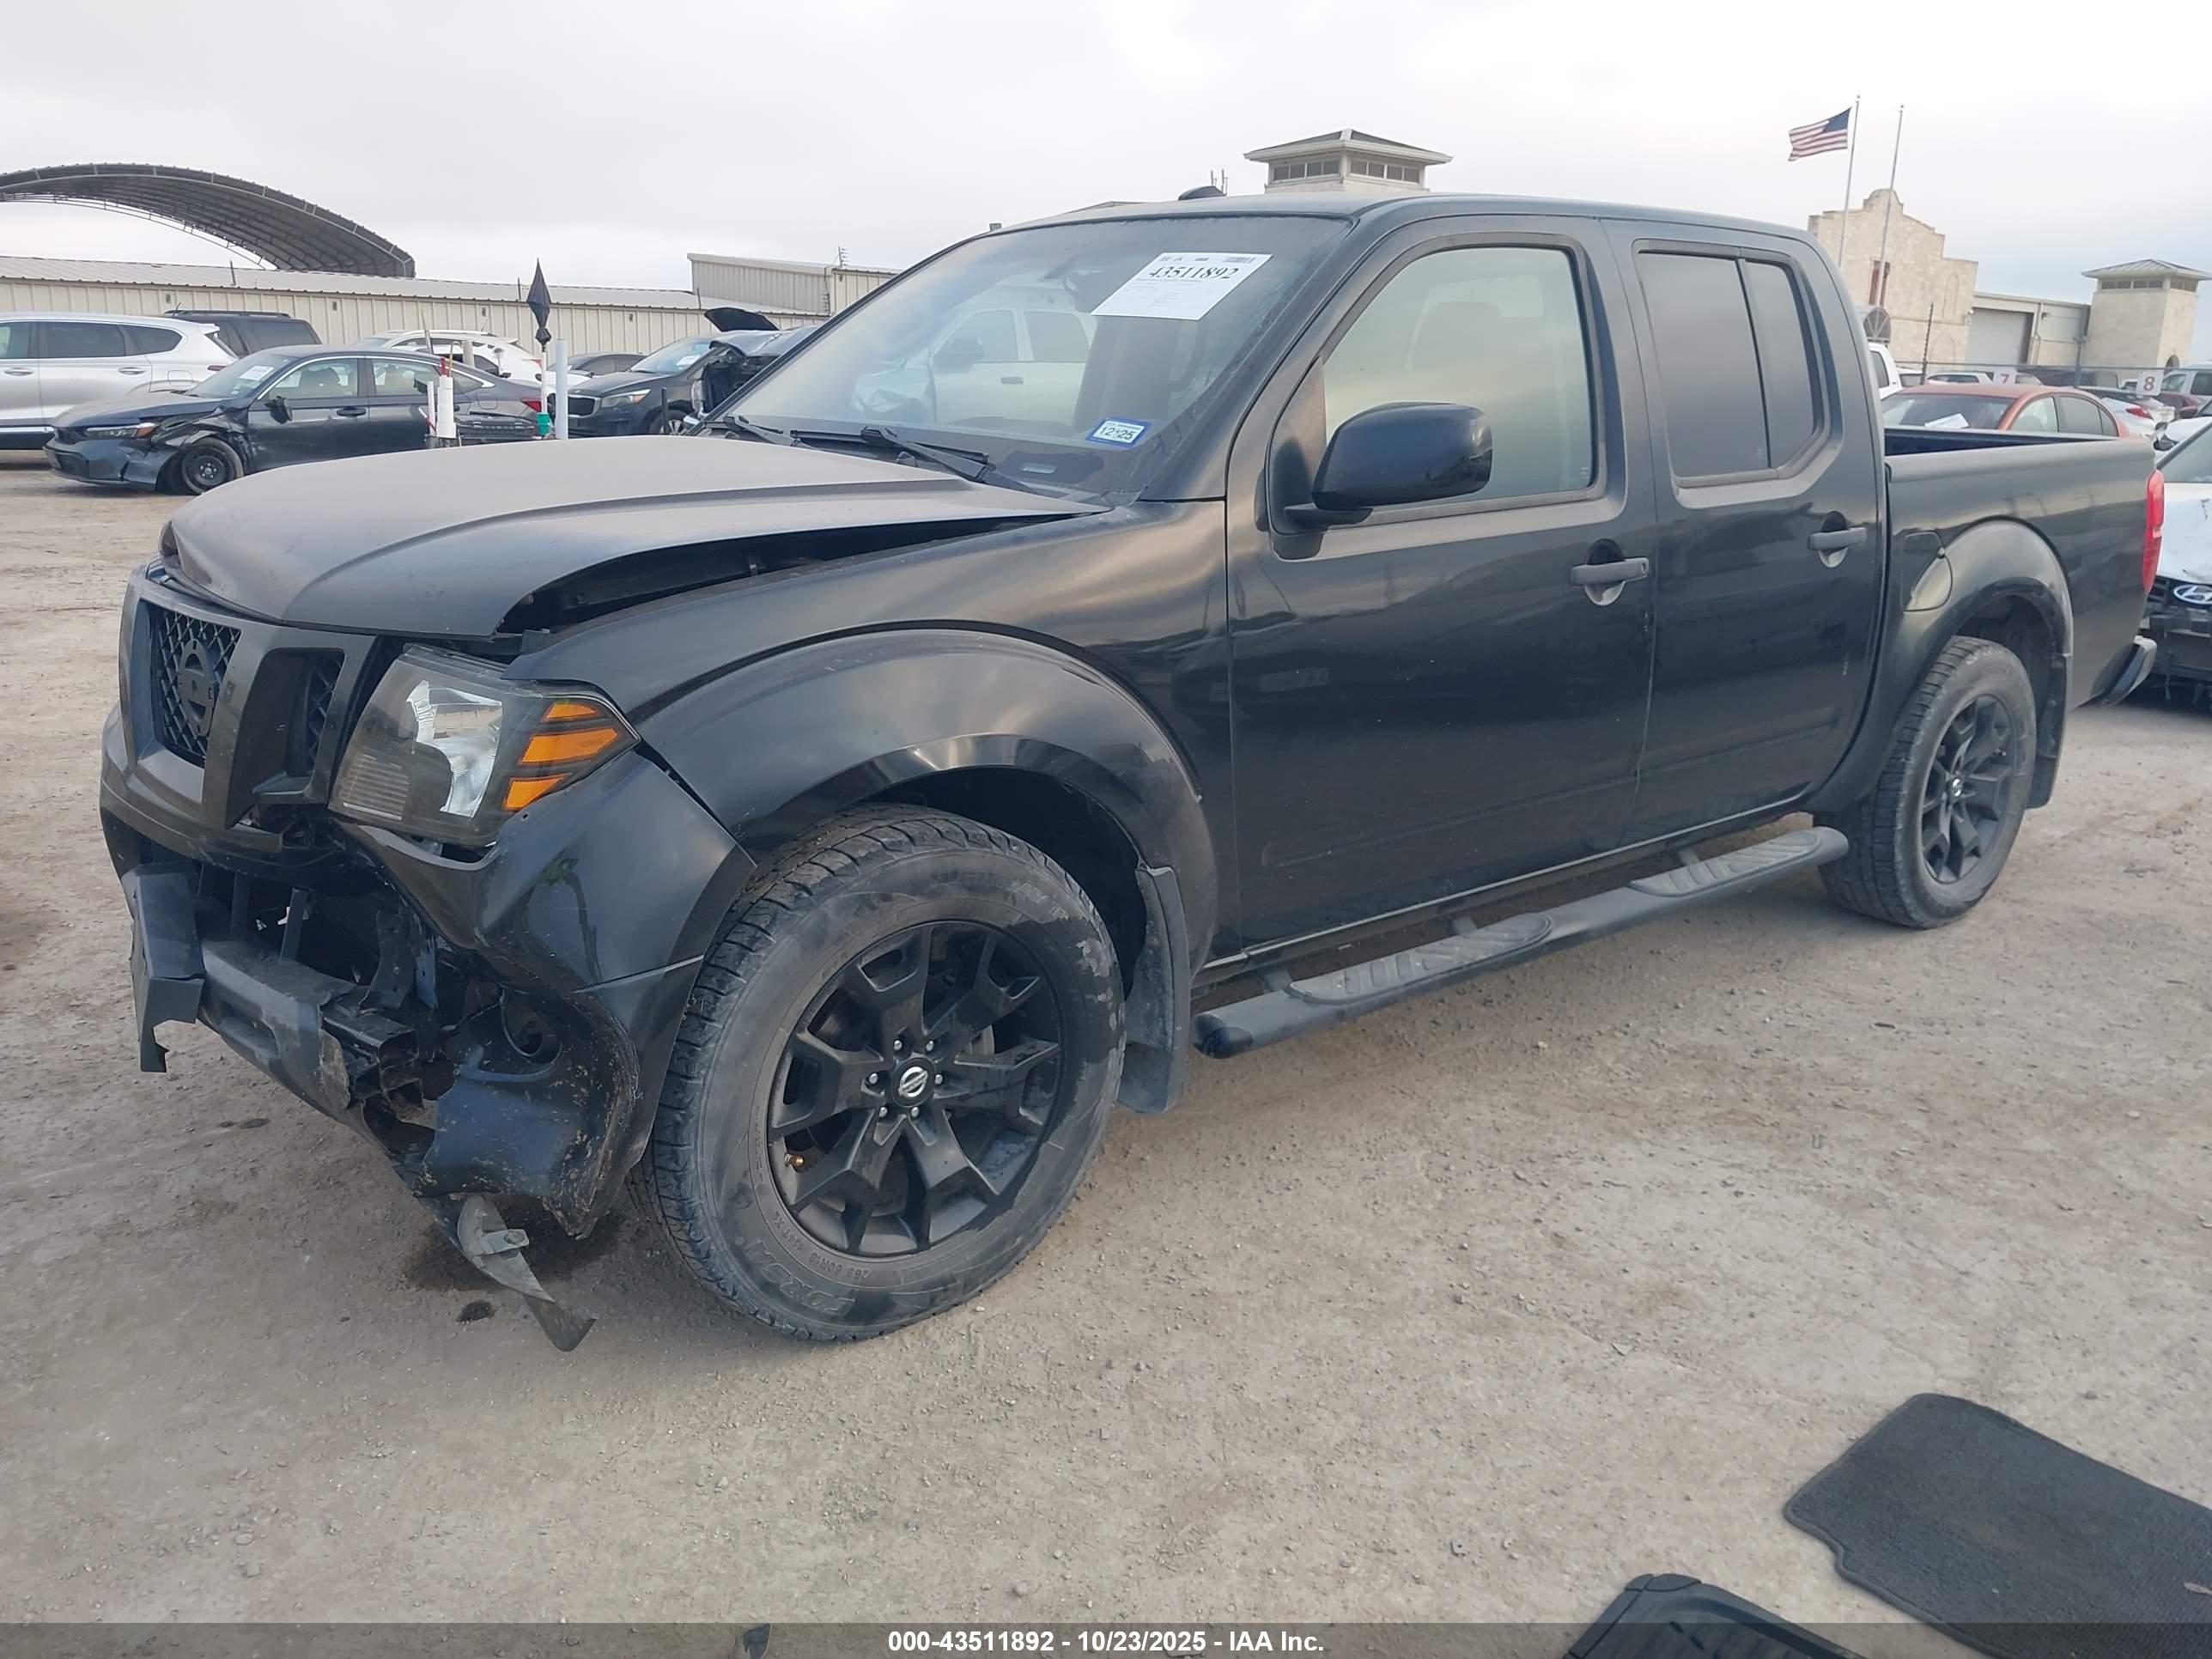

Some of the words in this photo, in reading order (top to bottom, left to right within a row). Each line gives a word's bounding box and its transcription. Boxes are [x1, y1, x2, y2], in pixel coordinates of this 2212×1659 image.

[1149, 266, 1239, 279] 43511892
[2000, 373, 2010, 384] 7
[2143, 376, 2155, 392] 8
